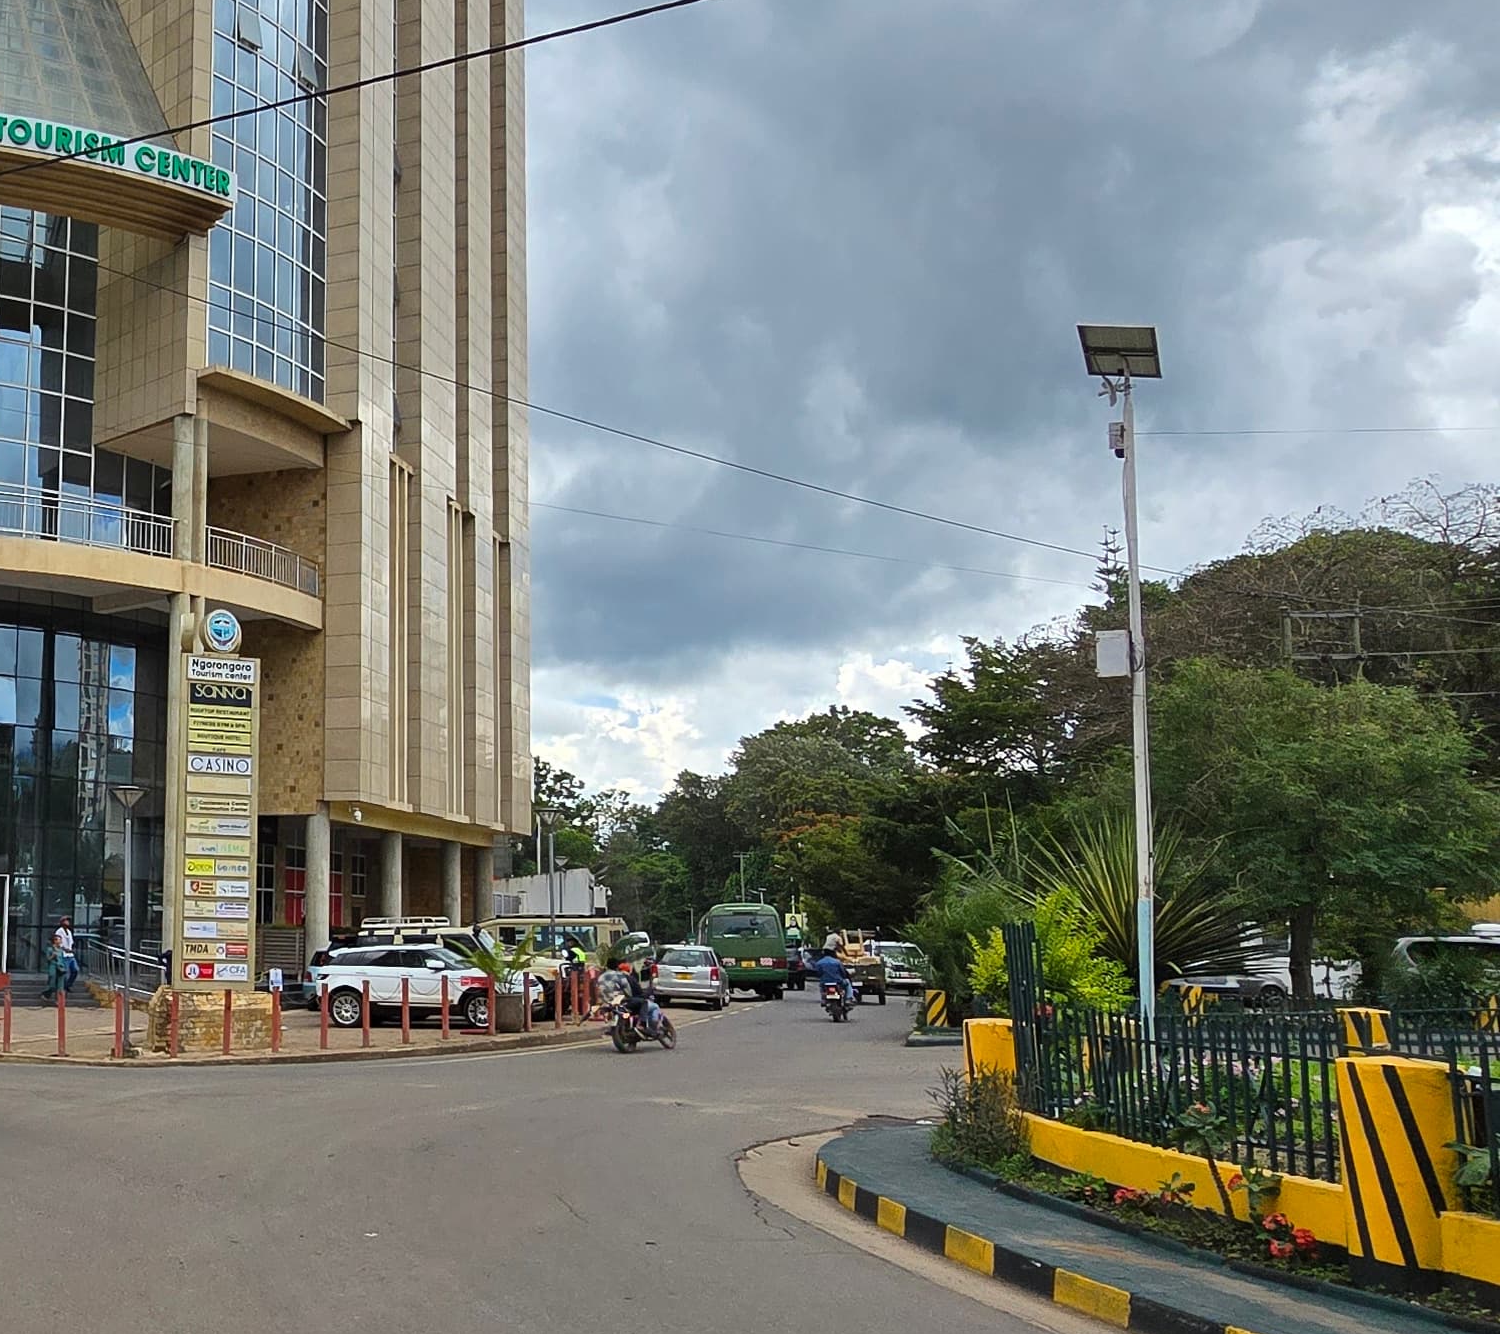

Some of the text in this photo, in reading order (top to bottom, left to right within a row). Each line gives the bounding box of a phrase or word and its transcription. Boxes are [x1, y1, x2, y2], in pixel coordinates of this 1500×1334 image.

[135, 146, 230, 197] CENTER
[192, 659, 252, 673] Ngorongoro
[192, 669, 223, 678] Tourism
[191, 757, 249, 773] CASINO
[185, 944, 209, 954] TMDA
